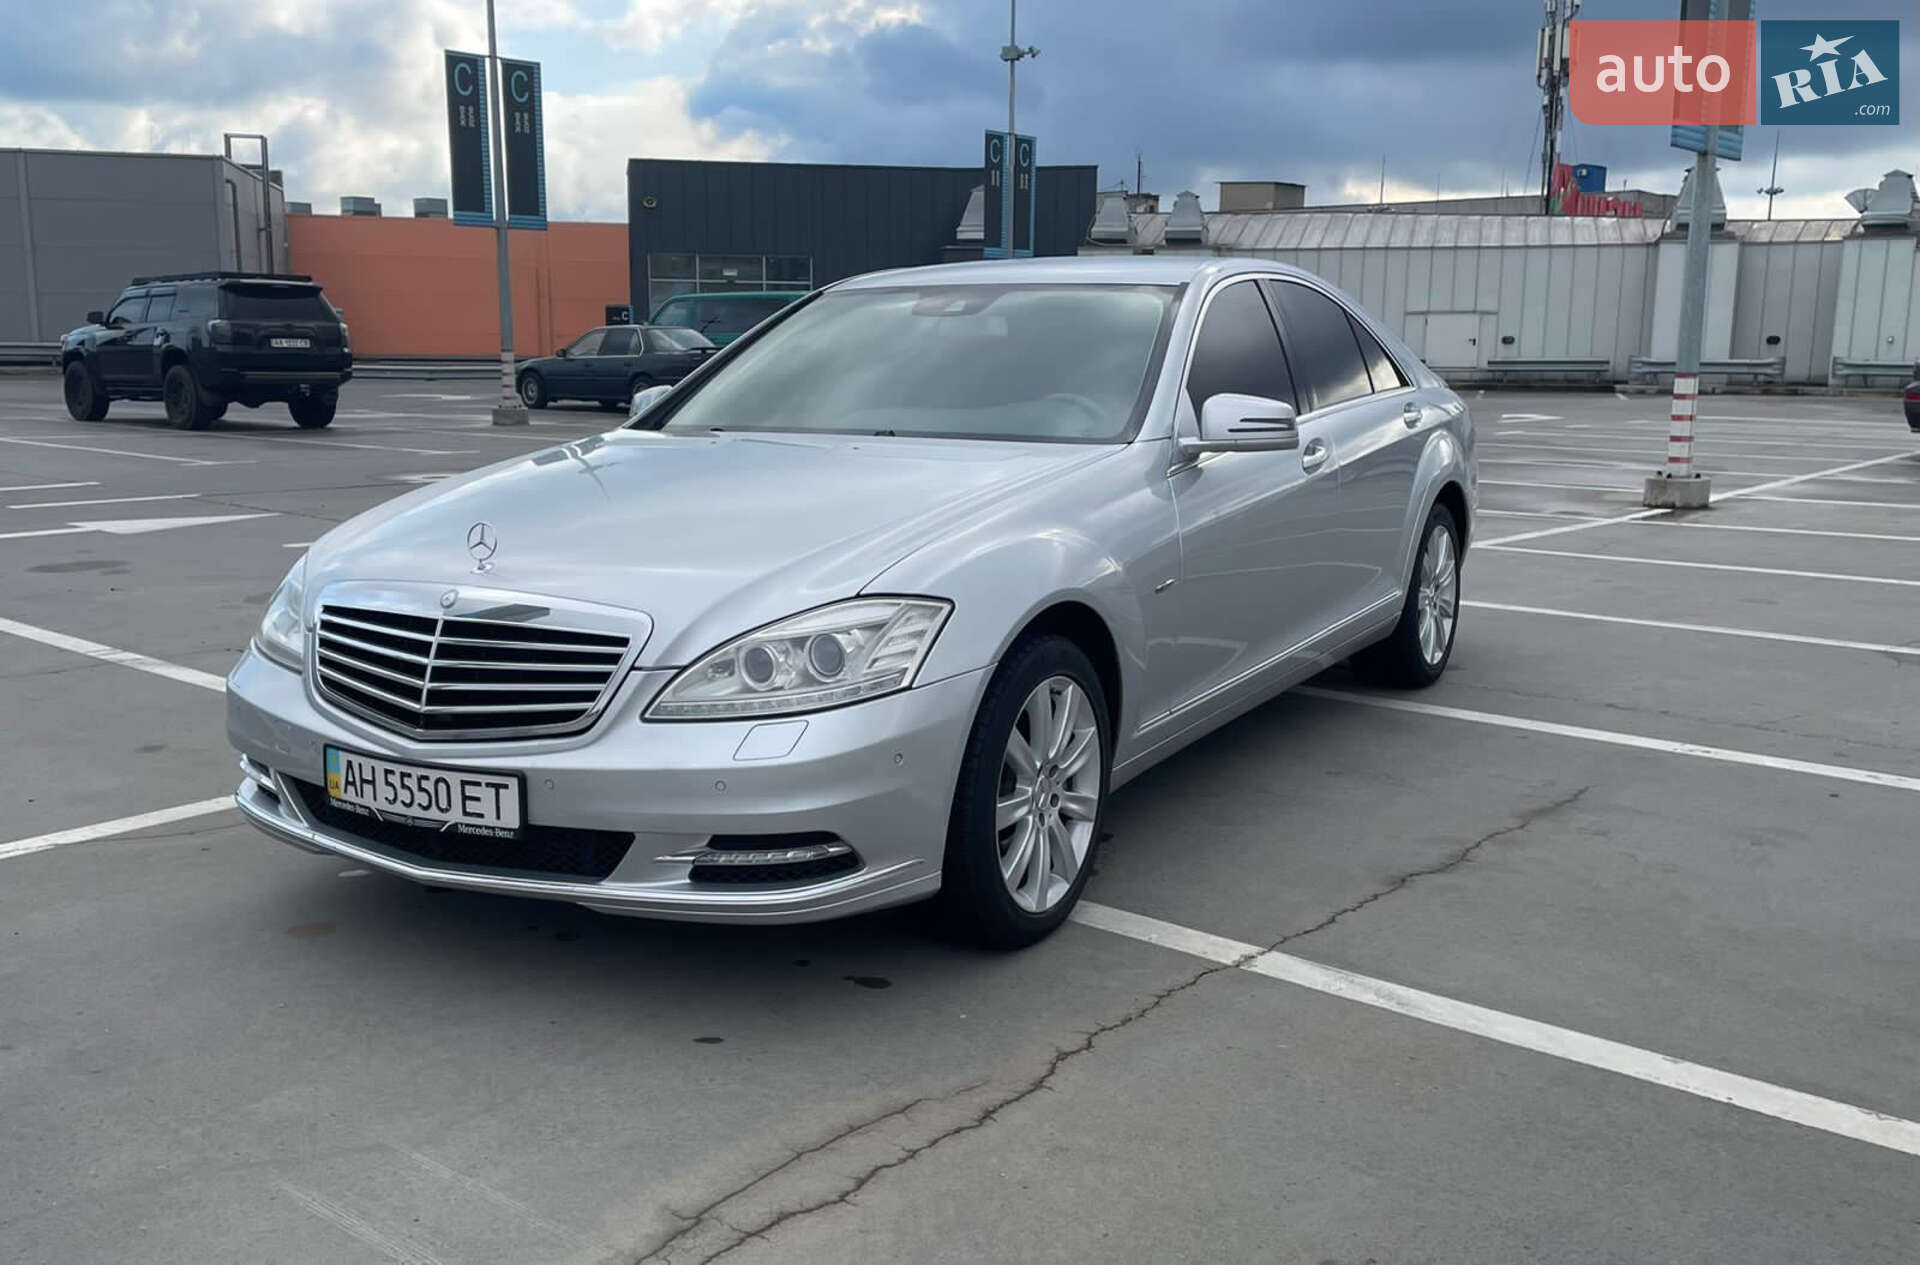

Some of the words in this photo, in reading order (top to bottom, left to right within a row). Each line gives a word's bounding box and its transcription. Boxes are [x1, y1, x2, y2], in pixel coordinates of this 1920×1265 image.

[454, 63, 473, 96] C
[511, 70, 529, 103] C
[990, 138, 1001, 163] C
[1019, 143, 1030, 167] C
[329, 774, 340, 790] UA
[343, 759, 377, 802] AH
[383, 767, 453, 814] 5550
[460, 779, 509, 821] ET
